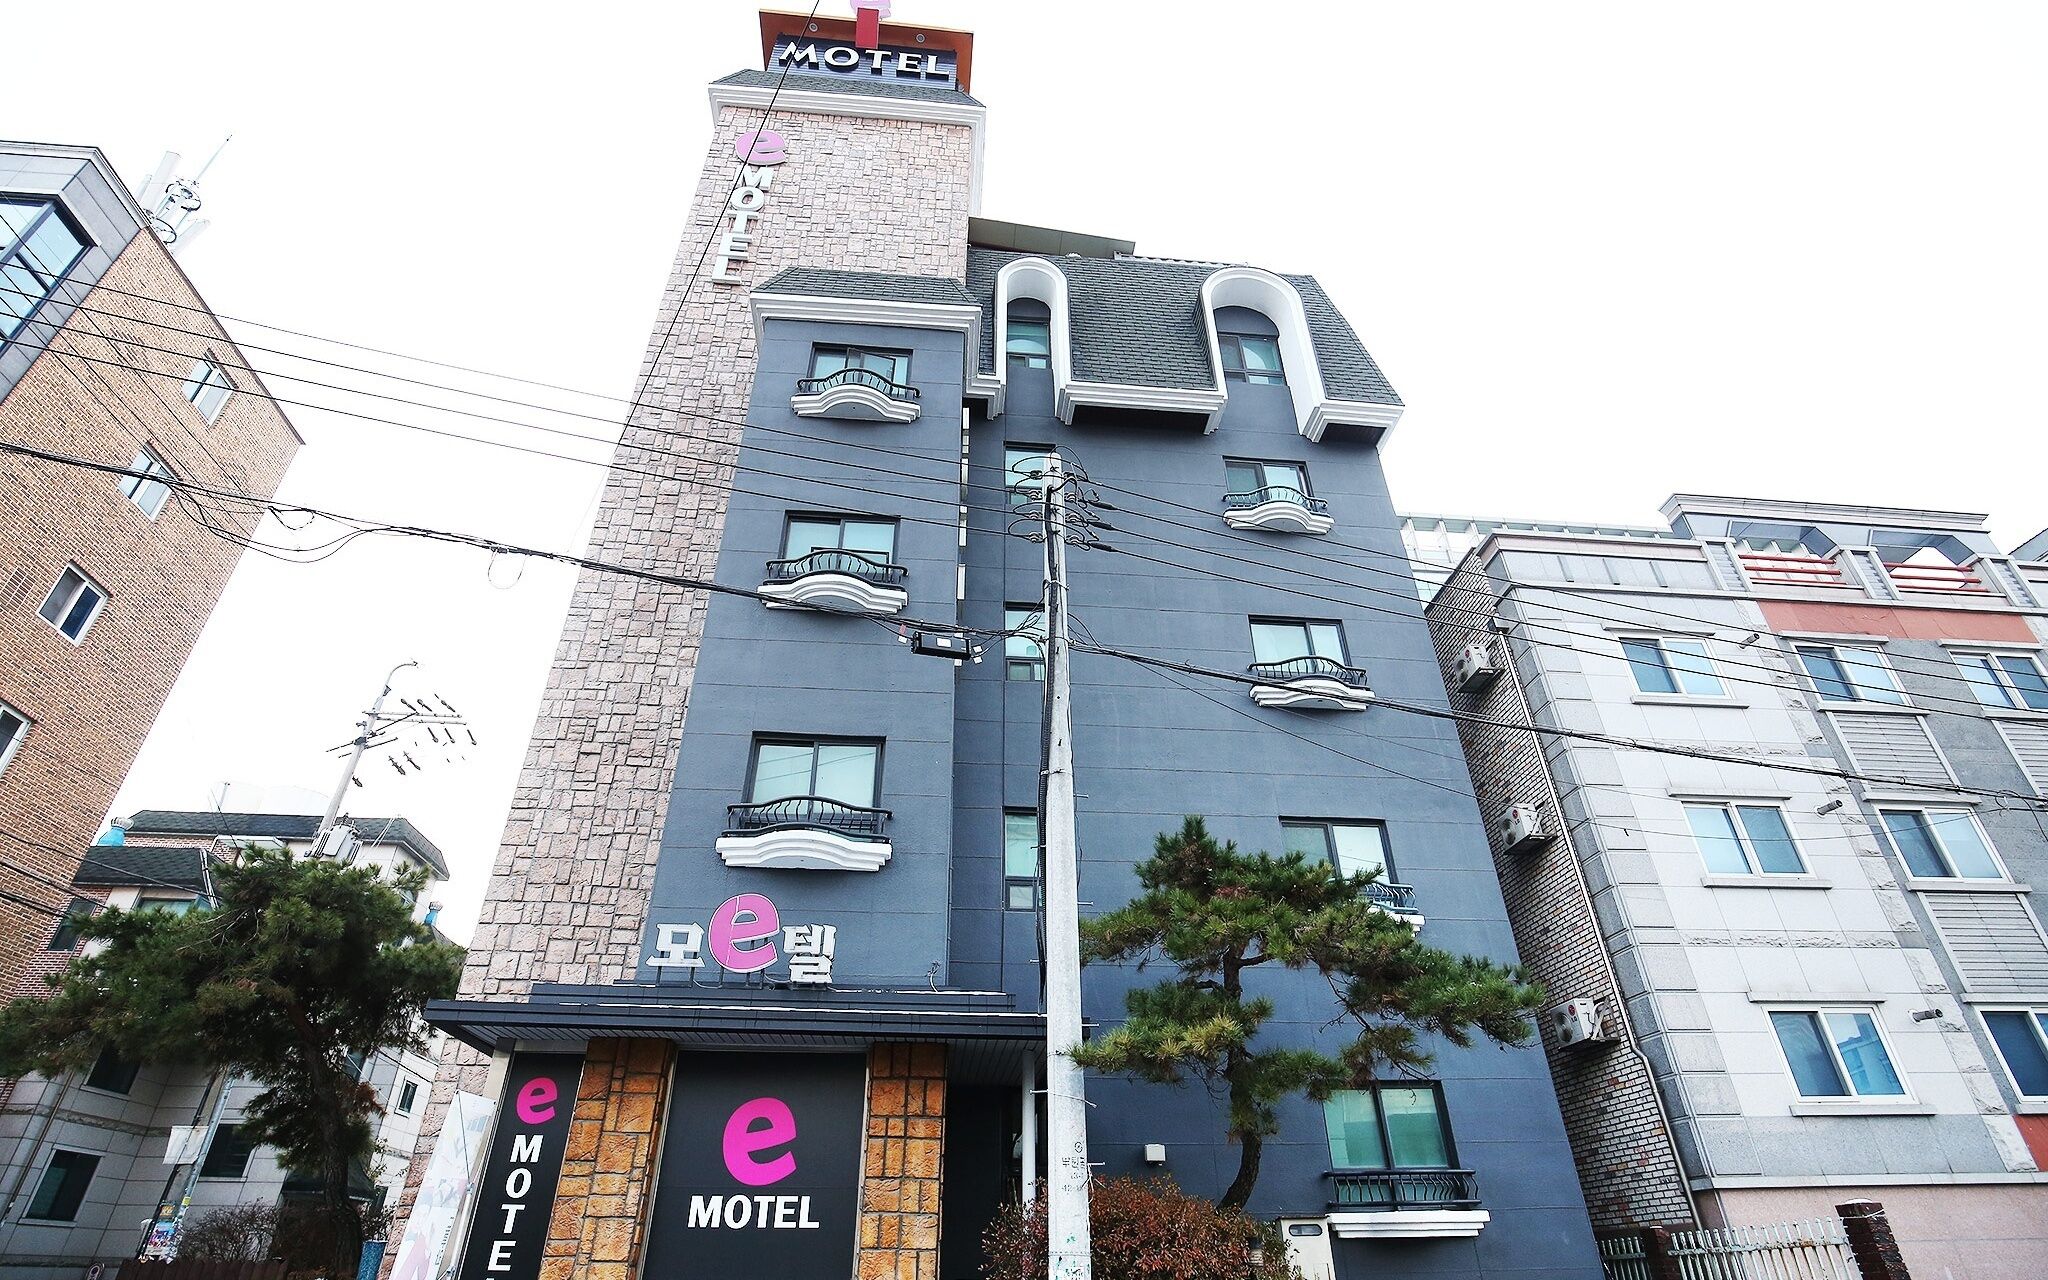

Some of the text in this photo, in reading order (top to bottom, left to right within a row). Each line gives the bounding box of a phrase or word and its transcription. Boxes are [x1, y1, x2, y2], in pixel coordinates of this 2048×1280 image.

[778, 41, 950, 79] MOTEL
[711, 129, 787, 285] e MOTEL
[485, 1076, 558, 1280] e MOTE
[722, 1097, 797, 1186] e
[688, 1195, 820, 1229] MOTEL
